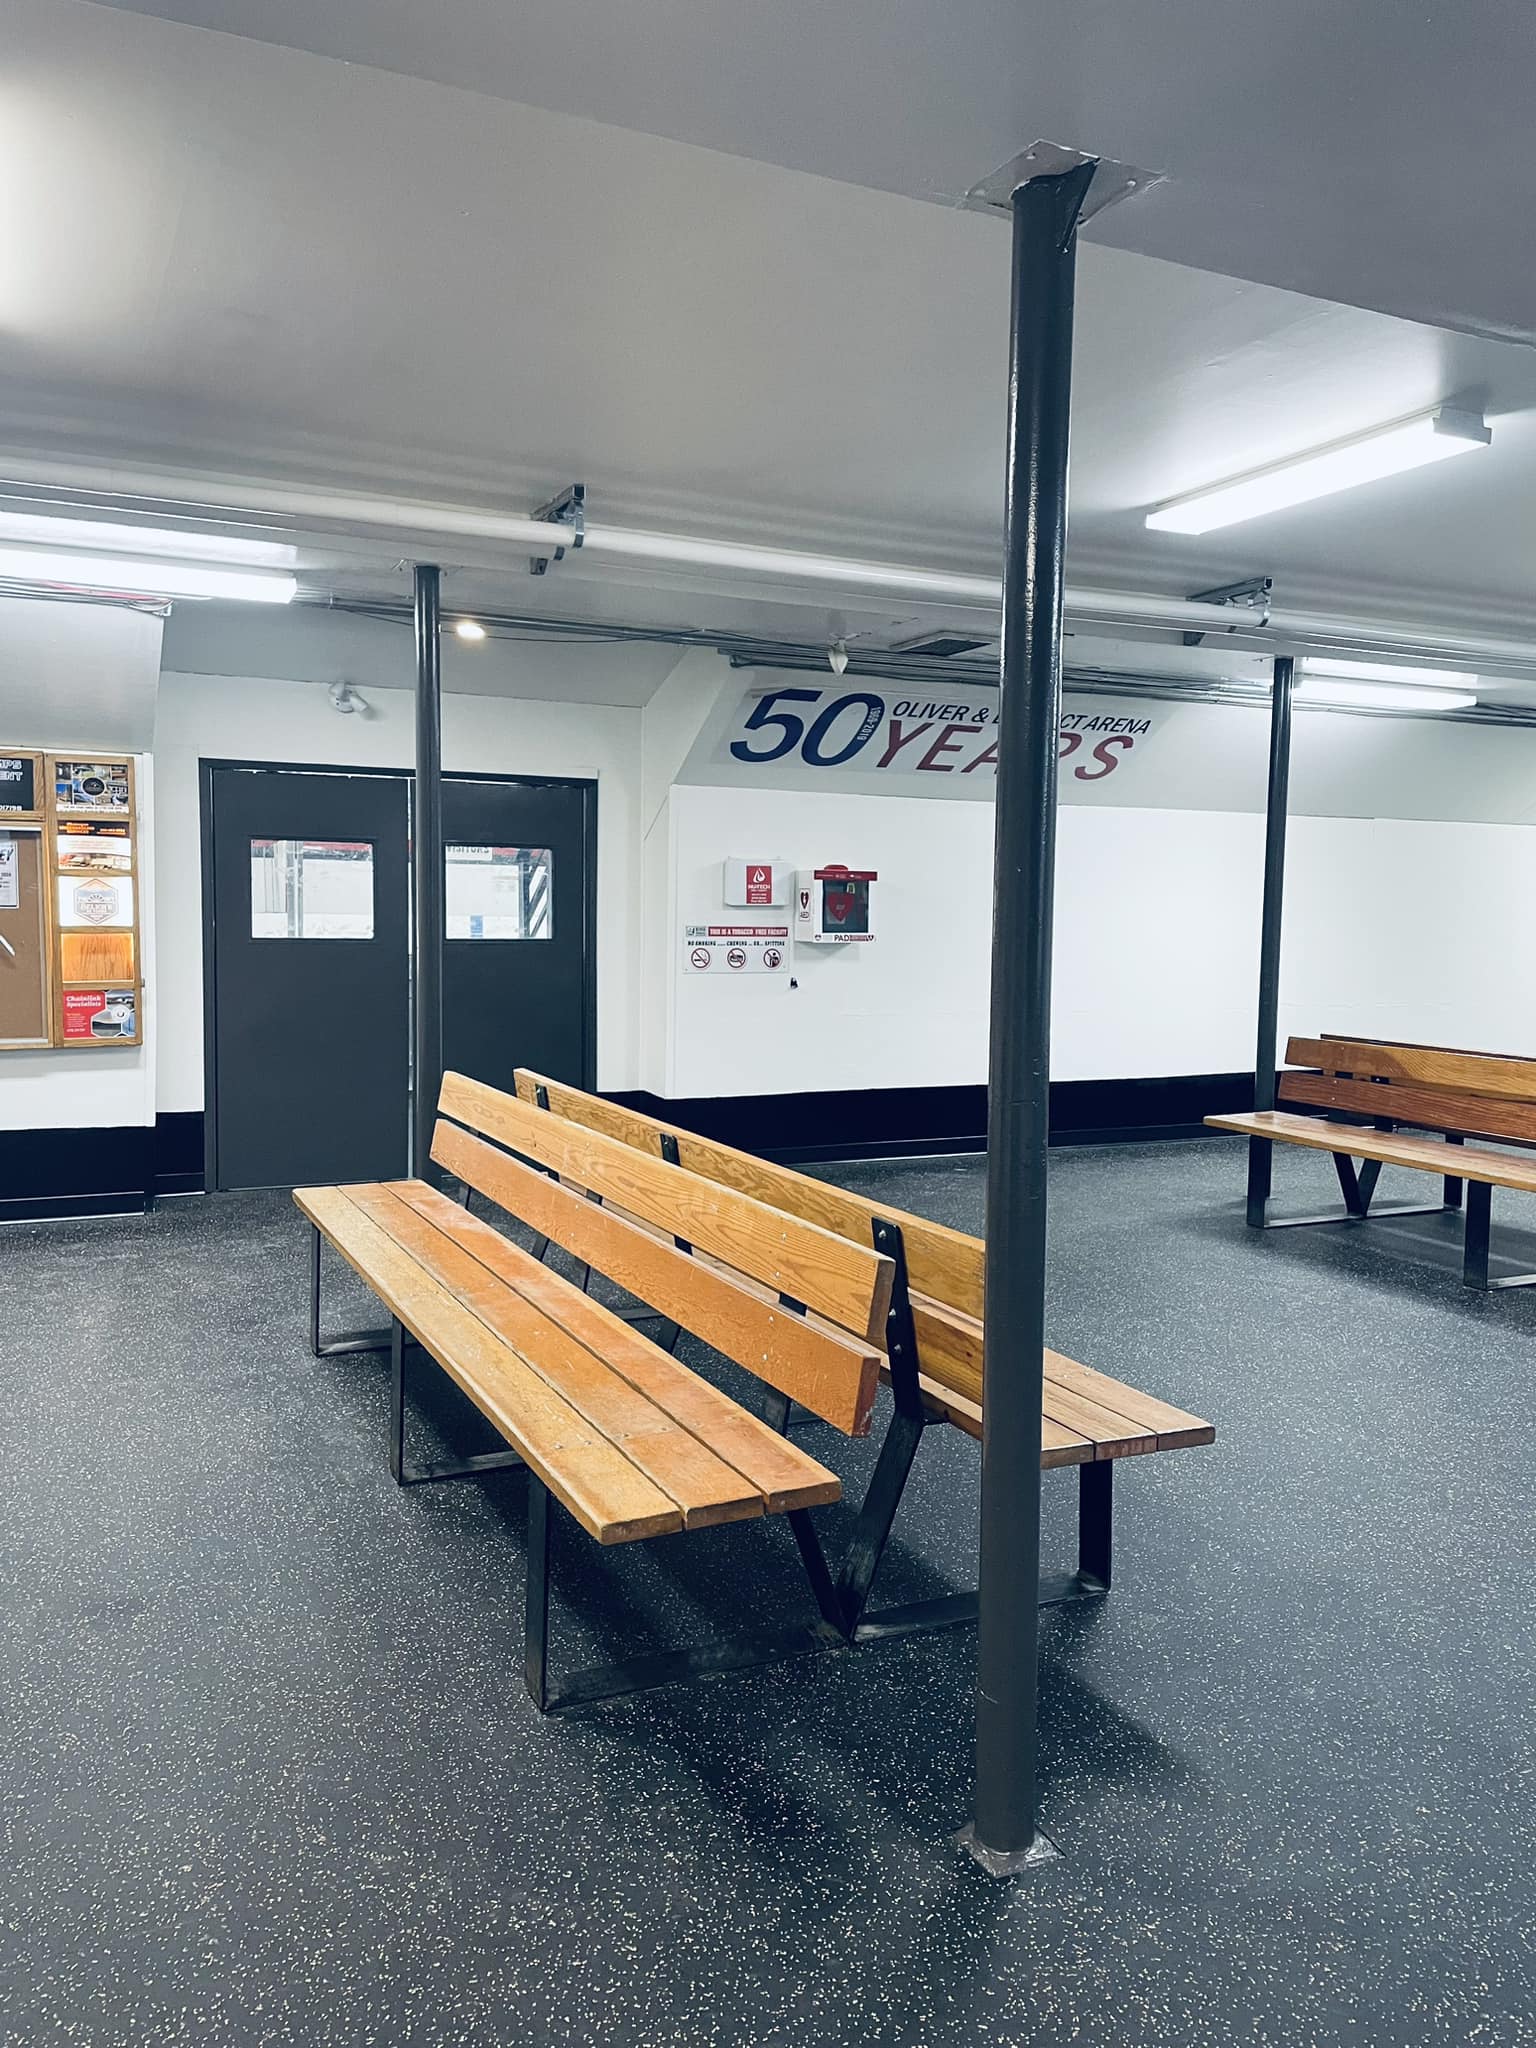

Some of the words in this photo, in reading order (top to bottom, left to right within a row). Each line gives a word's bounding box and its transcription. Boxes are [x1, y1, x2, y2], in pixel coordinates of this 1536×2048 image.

[730, 688, 886, 767] 50
[892, 701, 970, 721] OLIVER
[971, 707, 990, 723] &
[1085, 714, 1152, 735] ARENA
